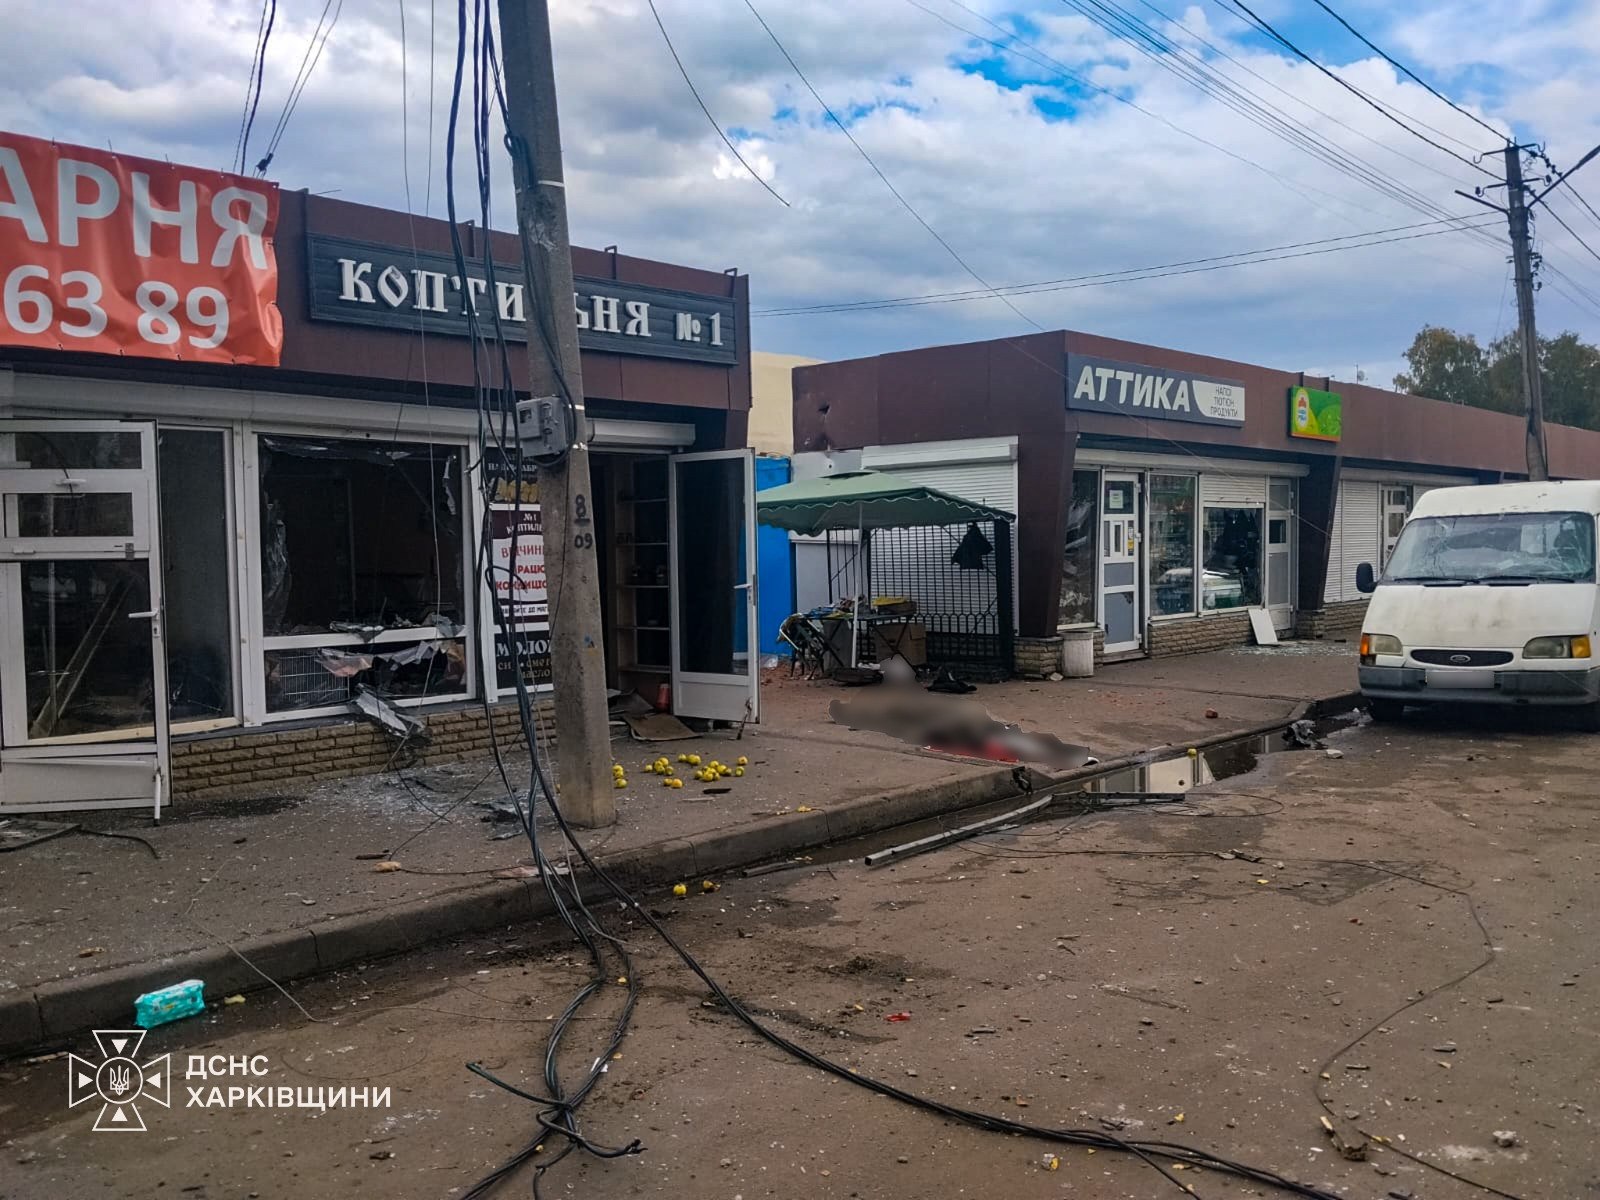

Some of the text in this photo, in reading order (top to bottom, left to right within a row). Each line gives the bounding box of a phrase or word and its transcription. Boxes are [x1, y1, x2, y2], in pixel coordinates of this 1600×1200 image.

[4, 265, 230, 349] 63 89
[338, 258, 652, 337] КОПТИЬНЯ
[1073, 365, 1191, 413] АТТИКА
[574, 533, 594, 549] 09
[496, 639, 551, 657] МОЛО
